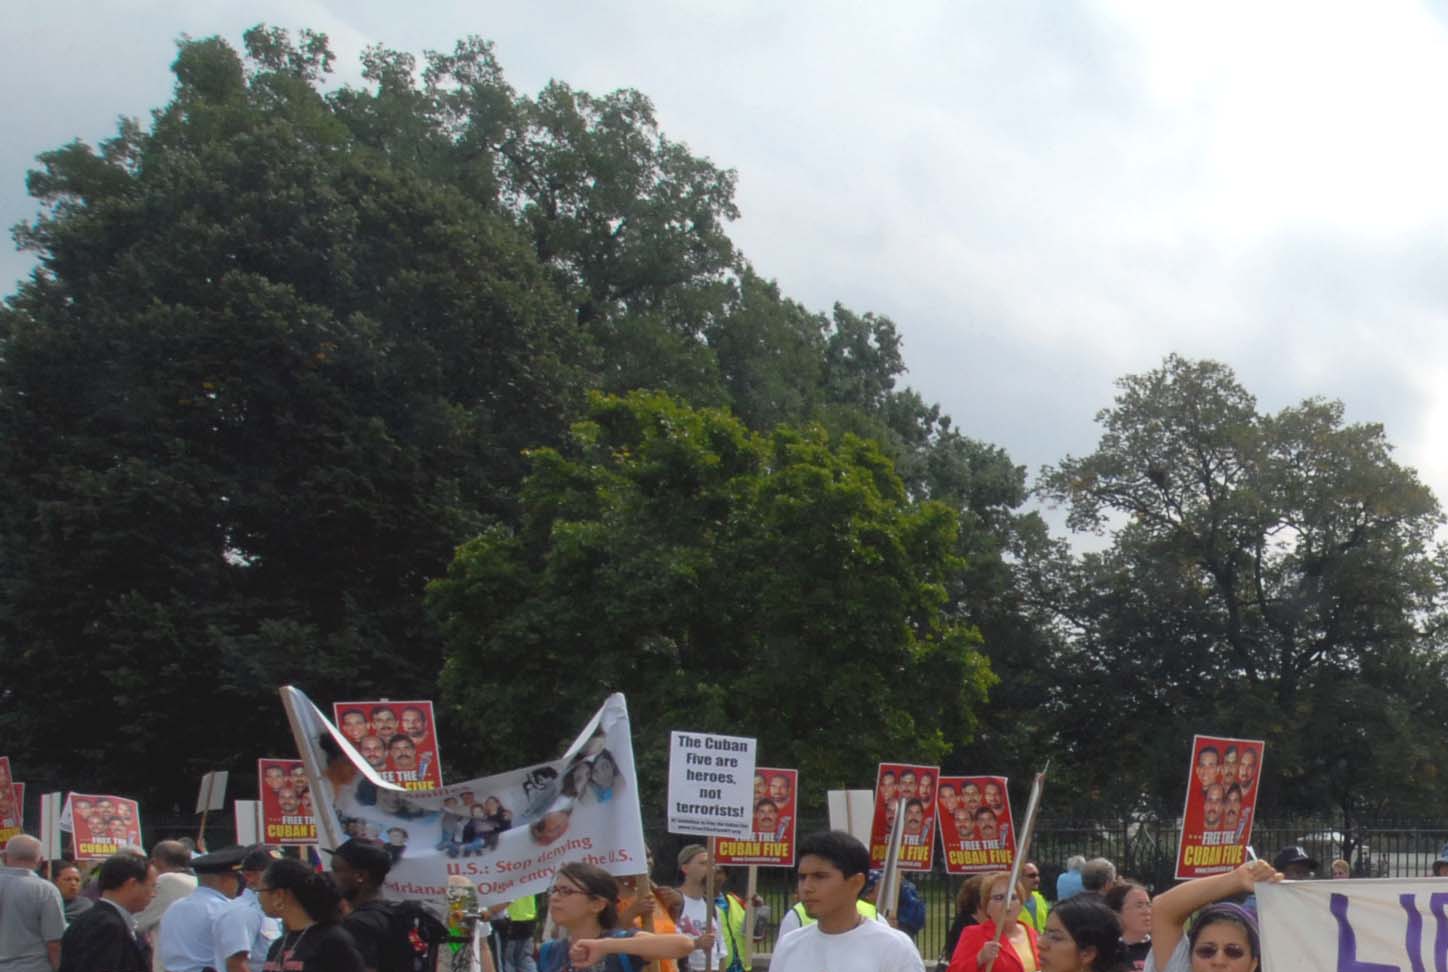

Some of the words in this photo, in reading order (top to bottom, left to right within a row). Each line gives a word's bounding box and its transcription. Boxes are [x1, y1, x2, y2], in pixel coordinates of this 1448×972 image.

[678, 735, 702, 749] The
[704, 737, 749, 753] Cuban
[686, 753, 713, 766] Five
[715, 757, 739, 768] are
[699, 788, 722, 800] not
[676, 802, 745, 818] terrorists!
[267, 825, 309, 838] CUBAN
[446, 861, 490, 877] U.S.:
[495, 859, 533, 875] Stop
[537, 836, 593, 865] denying
[719, 841, 761, 856] CUBAN
[763, 842, 790, 857] FIVE
[1183, 845, 1223, 867] CUBAN
[1222, 845, 1244, 865] FIVE
[949, 850, 988, 865] CUBAN
[477, 878, 514, 896] Olga
[519, 864, 558, 885] entry
